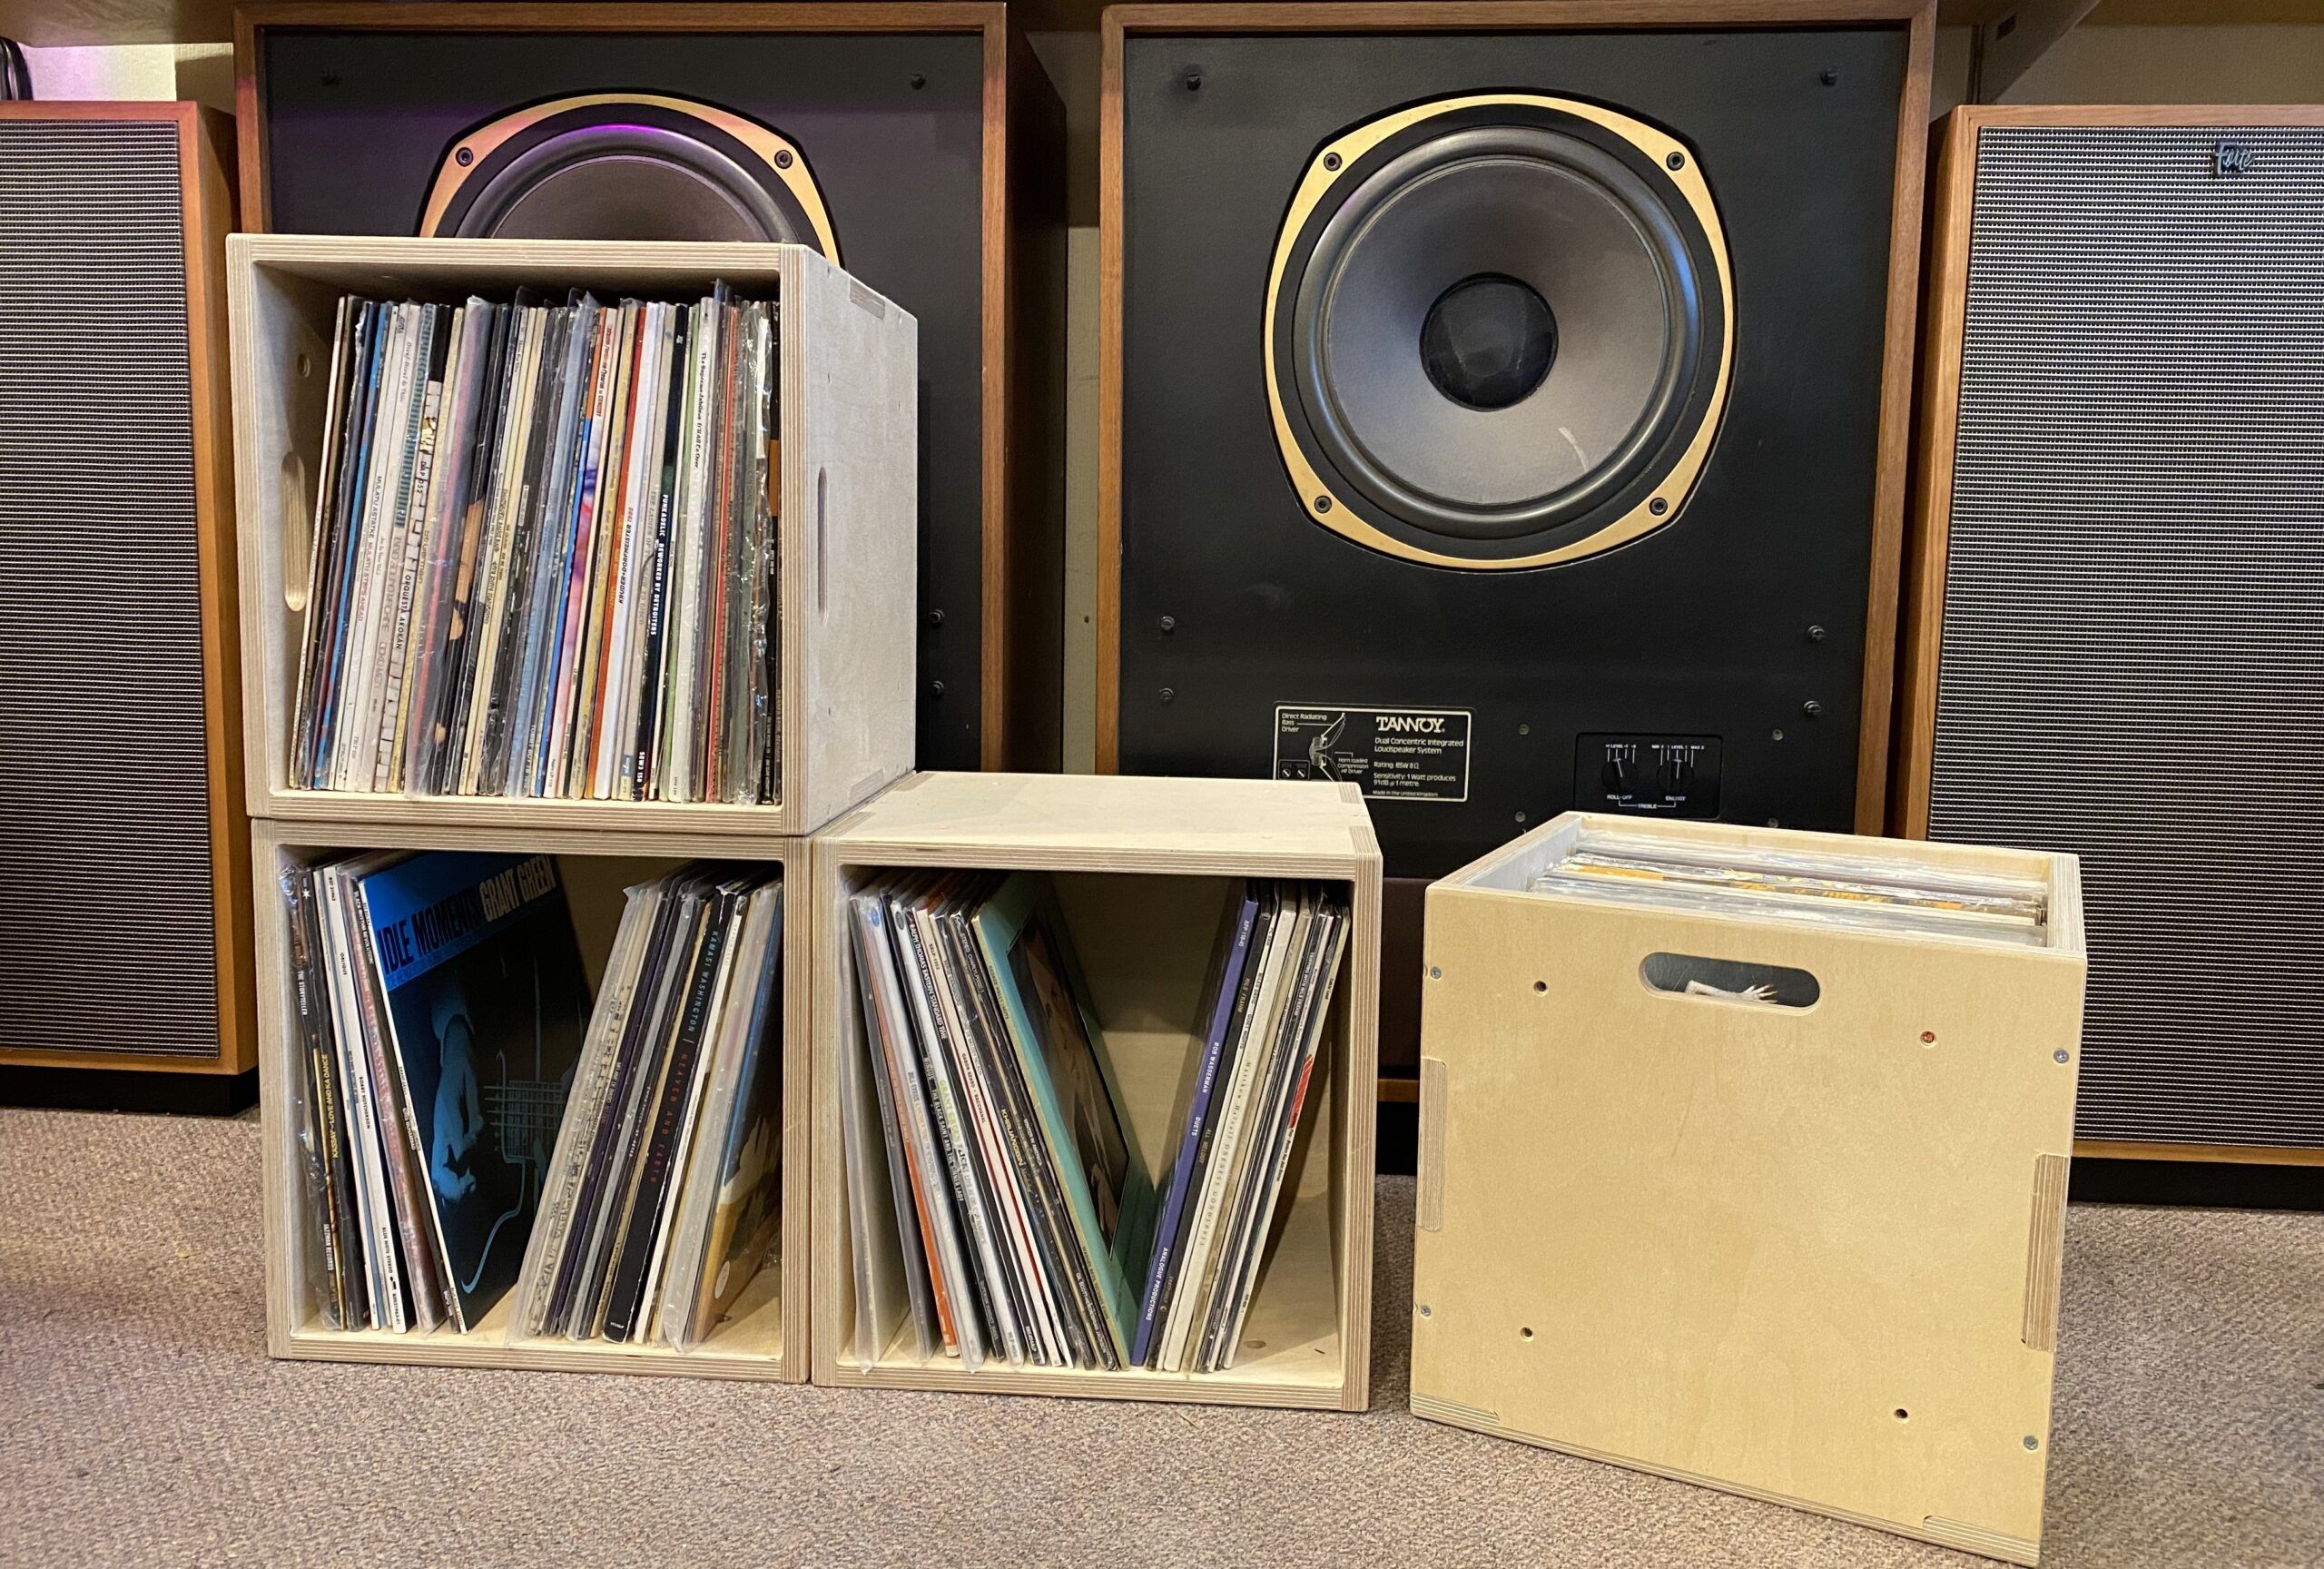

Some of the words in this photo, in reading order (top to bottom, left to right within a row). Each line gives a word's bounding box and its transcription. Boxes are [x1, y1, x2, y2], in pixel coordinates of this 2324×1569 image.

[660, 494, 668, 536] FUNKADELIC
[645, 538, 651, 548] OF
[400, 575, 411, 613] ORQUESTA
[655, 583, 661, 592] BY
[651, 594, 659, 635] DETROITERS
[1376, 716, 1444, 733] TANNOY
[1417, 746, 1442, 755] System
[1428, 739, 1464, 747] Integrated
[377, 922, 414, 975] IDLE
[411, 889, 480, 955] MOMENTS
[479, 867, 521, 923] GRANT
[517, 854, 556, 903] GREEN
[705, 932, 718, 966] KAMASI
[960, 933, 970, 952] STEREO
[910, 923, 919, 942] RALPH
[915, 943, 927, 968] THOMAS
[922, 969, 933, 994] EASTERN
[931, 995, 943, 1025] STANDARD
[939, 1026, 947, 1041] TIME
[989, 966, 998, 985] GEORGE
[1255, 972, 1264, 989] MILES
[299, 982, 307, 1016] STORYTELLER
[689, 972, 708, 1031] WASHINGTON
[1237, 993, 1246, 1012] FRAHM
[1250, 989, 1259, 1005] DAVIS
[1238, 1030, 1248, 1051] NIGHTS
[321, 1054, 330, 1078] DANCE
[671, 1054, 687, 1101] HEAVEN
[908, 1071, 916, 1084] BILL
[1203, 1057, 1216, 1092] WASSERMAN
[325, 1079, 330, 1089] KA
[1237, 1061, 1251, 1099] Matthew
[931, 1089, 940, 1100] THE
[362, 1095, 370, 1129] HUTCHERSON
[935, 1102, 944, 1120] BLACK
[939, 1080, 953, 1110] GRANT
[947, 1112, 962, 1142] GREEN
[974, 1094, 985, 1123] BACCHANAL
[662, 1110, 673, 1134] AND
[940, 1120, 949, 1139] SAINT
[1192, 1117, 1200, 1136] DUETS
[406, 1121, 417, 1150] MUHAMMAD
[944, 1139, 952, 1151] AND
[1002, 1110, 1025, 1166] KHRUANGBIN
[1024, 1119, 1033, 1138] WINTER
[1032, 1144, 1042, 1166] AMERICA
[651, 1144, 665, 1182] EARTH
[1199, 1141, 1207, 1163] MELODY
[950, 1165, 960, 1187] SINNER
[1216, 1144, 1229, 1186] ONENESS
[955, 1188, 965, 1202] LADY
[1157, 1248, 1167, 1278] ANALOGUE
[1147, 1280, 1160, 1320] PRODUCTIONS
[1095, 1330, 1108, 1354] JACKSON
